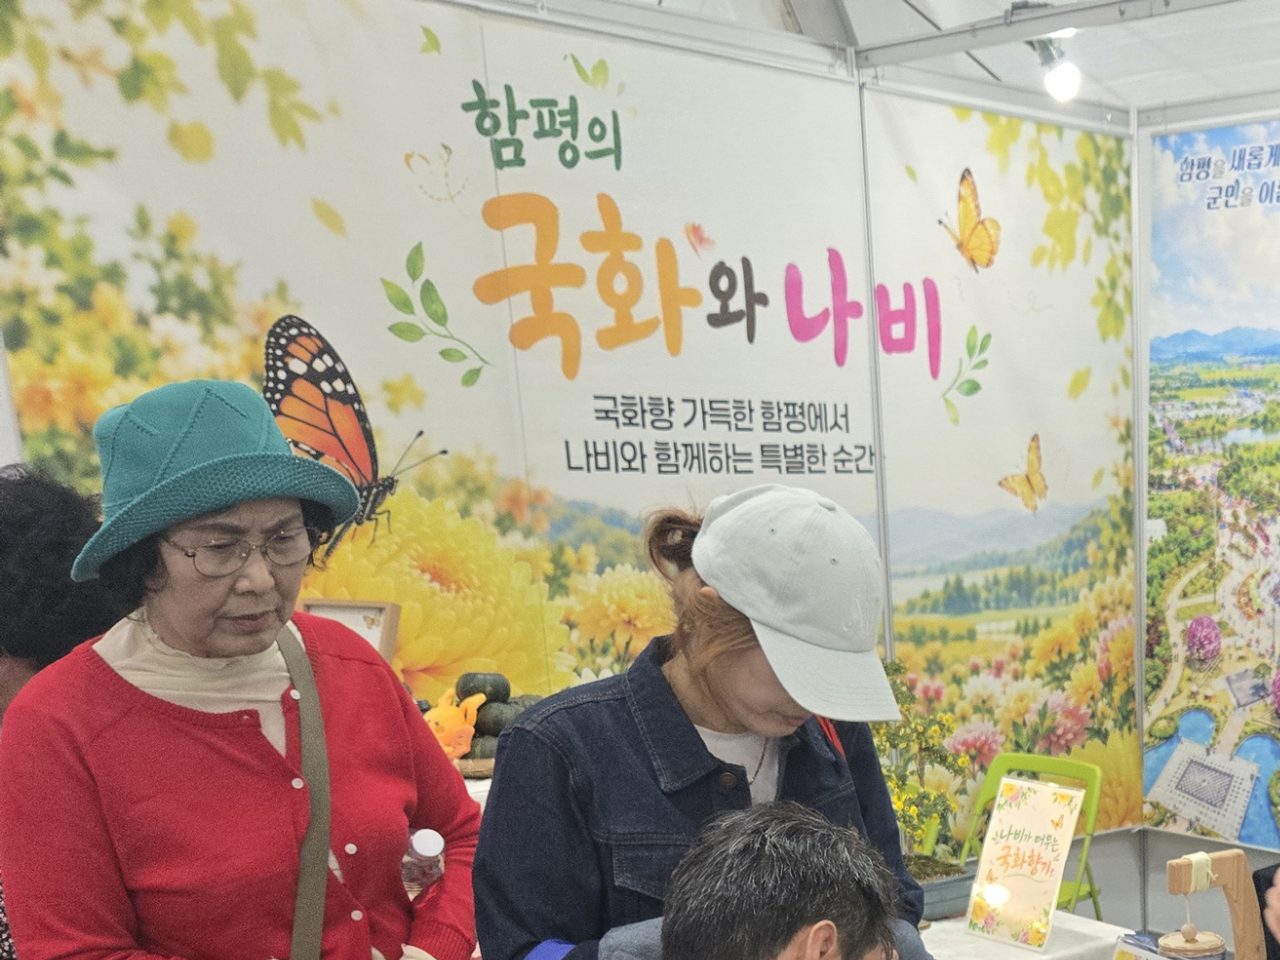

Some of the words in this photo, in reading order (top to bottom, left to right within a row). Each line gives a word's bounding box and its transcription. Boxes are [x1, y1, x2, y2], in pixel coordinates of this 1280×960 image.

[461, 77, 622, 171] 함평의
[784, 246, 942, 381] 나비
[592, 394, 676, 432] 국화향
[682, 398, 755, 434] 가득한
[760, 399, 850, 434] 함평에서
[564, 437, 648, 475] 나비와
[655, 441, 753, 476] 함께하는
[760, 443, 827, 476] 특별한
[833, 444, 876, 476] 순간
[1000, 825, 1032, 842] 나비가
[997, 844, 1052, 877] 국화향기
